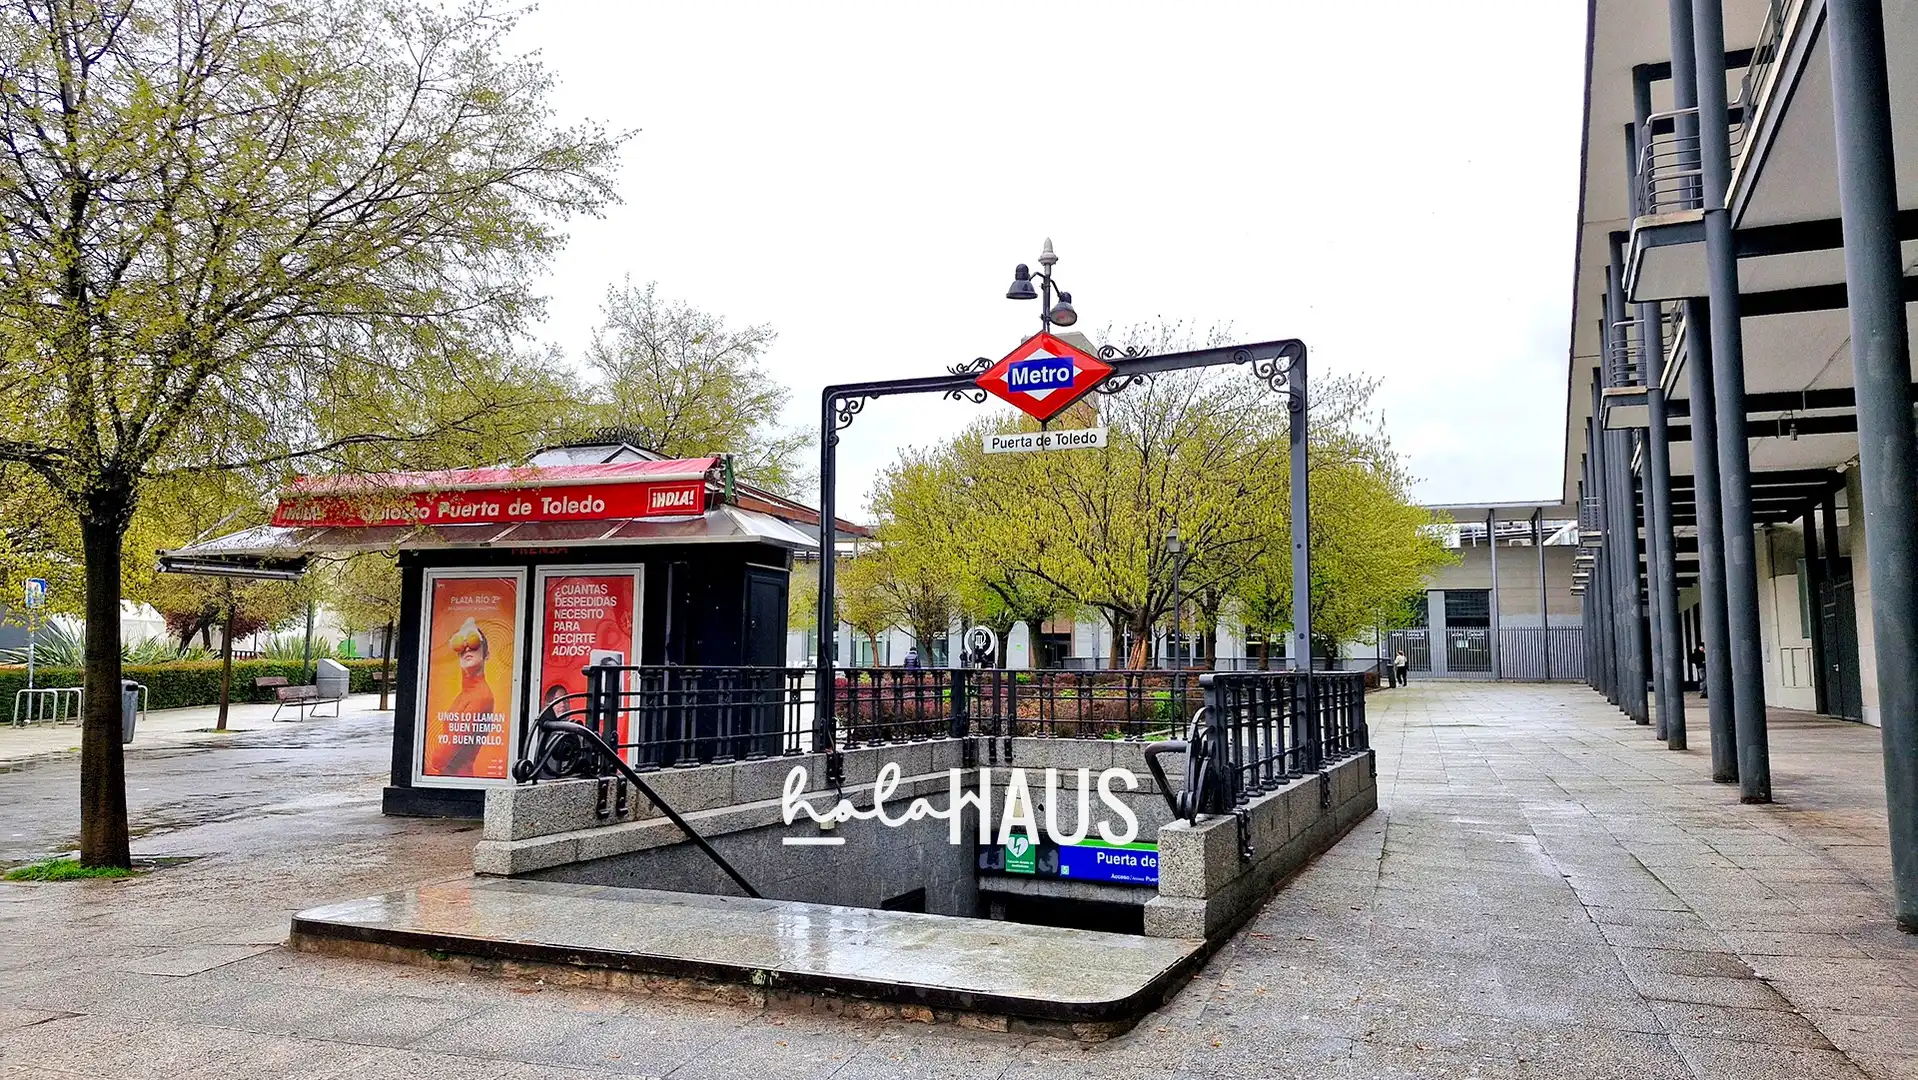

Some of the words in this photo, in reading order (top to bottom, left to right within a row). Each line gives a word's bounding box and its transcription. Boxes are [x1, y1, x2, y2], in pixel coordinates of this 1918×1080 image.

[1011, 366, 1070, 386] Metro
[992, 437, 1032, 450] Puerta
[1036, 435, 1051, 447] de
[1055, 432, 1098, 446] Toledo
[652, 490, 695, 508] ¡HOLA!
[438, 501, 500, 518] Puerta
[508, 498, 532, 515] de
[541, 495, 605, 515] Toledo
[554, 582, 608, 597] ¿CUÁNTAS
[450, 596, 473, 604] PLAZA
[554, 596, 617, 607] DESPEDIDAS
[554, 608, 605, 619] NECESITO
[553, 621, 581, 631] PARA
[552, 633, 597, 644] DECIRTE
[437, 712, 460, 721] UNOS
[461, 712, 472, 722] LO
[473, 712, 506, 723] LLAMAN
[448, 722, 471, 732] BUEN
[472, 723, 505, 733] TIEMPO.
[437, 734, 451, 745] YO,
[452, 735, 474, 745] BUEN
[475, 735, 504, 746] ROLLO.
[1096, 851, 1137, 866] Puerta
[1141, 855, 1157, 867] de
